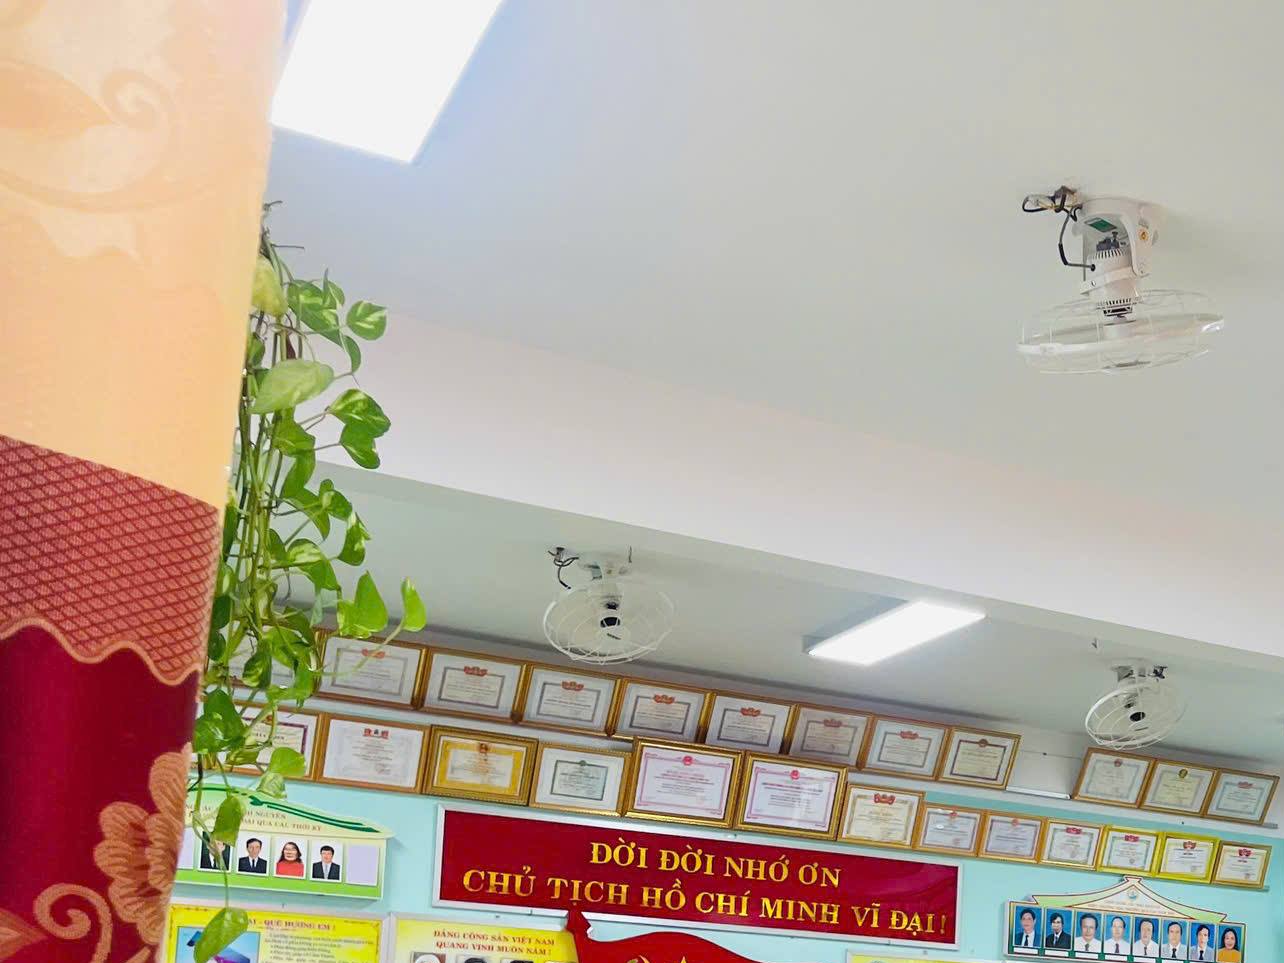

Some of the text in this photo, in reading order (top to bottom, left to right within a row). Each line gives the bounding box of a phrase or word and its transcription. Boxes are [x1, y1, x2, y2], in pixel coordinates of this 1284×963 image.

[590, 837, 842, 888] ĐỜI ĐỜI NHỚ ƠN
[463, 865, 536, 897] CHỦ
[547, 877, 630, 906] TỊCH
[640, 878, 686, 910] HỒ
[695, 890, 751, 917] CHÍ
[759, 897, 841, 925] MINH
[851, 903, 881, 928] VĨ
[436, 941, 469, 950] QUANG
[472, 944, 494, 952] VINH
[511, 936, 533, 945] VIỆT
[535, 938, 555, 946] NAM
